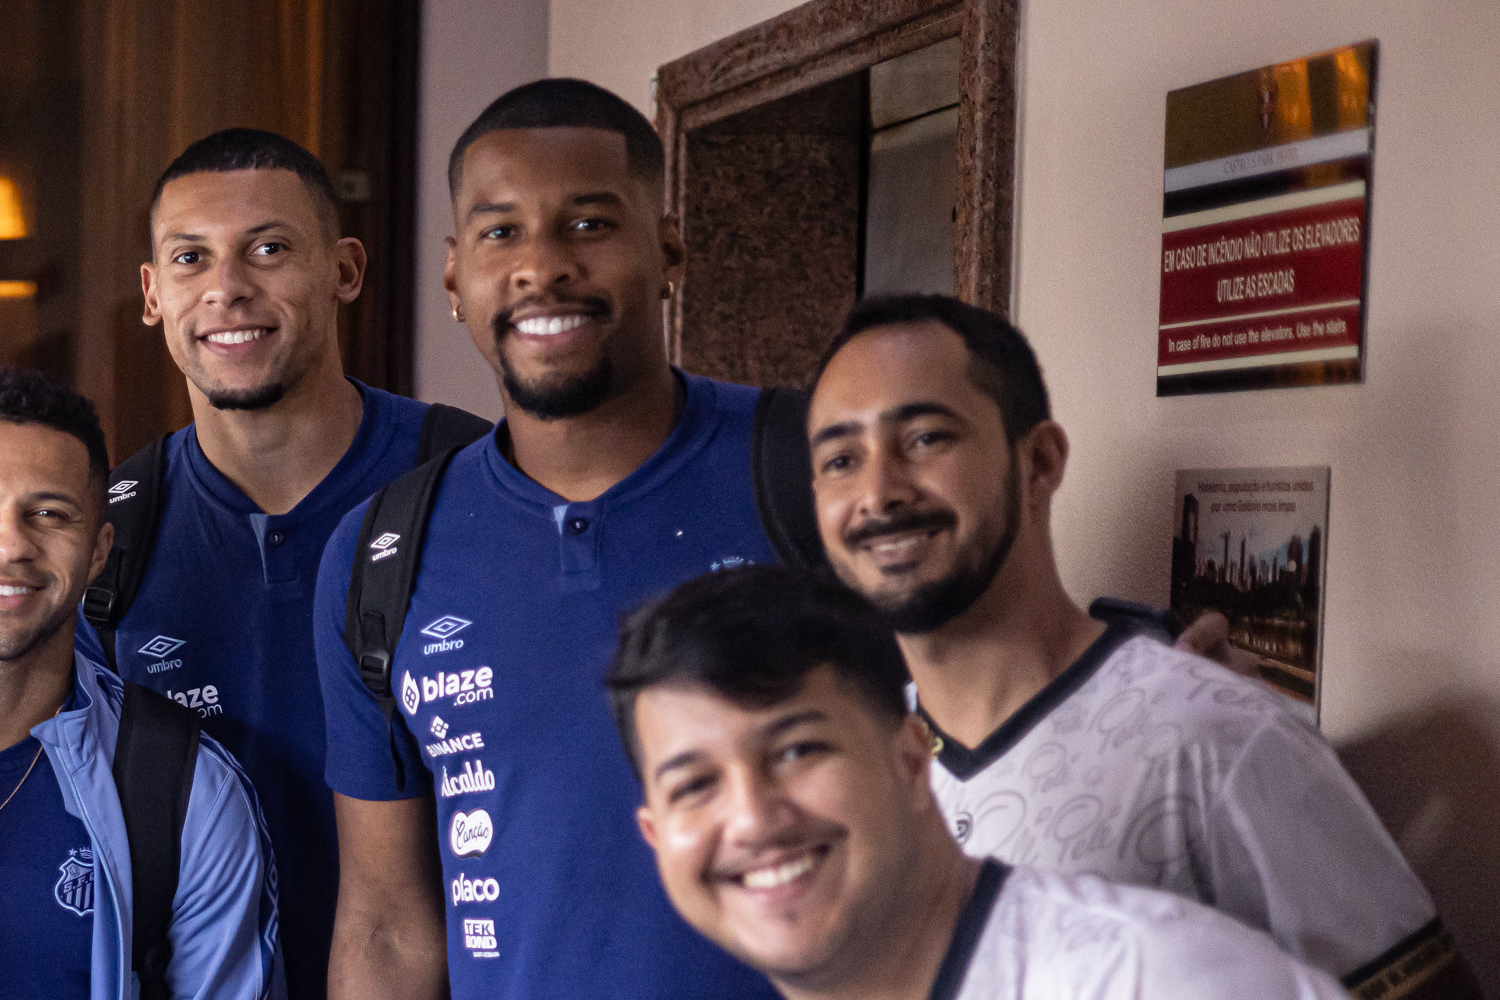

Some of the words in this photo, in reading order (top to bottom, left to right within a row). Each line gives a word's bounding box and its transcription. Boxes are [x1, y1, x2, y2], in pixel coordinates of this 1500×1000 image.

[1164, 250, 1175, 273] EM
[1176, 246, 1195, 270] CASO
[1197, 244, 1207, 267] DE
[1208, 235, 1242, 265] INCÊNDIO
[1244, 231, 1261, 259] NÃO
[1262, 229, 1291, 256] UTILIZE
[1292, 226, 1305, 250] OS
[1306, 217, 1361, 249] ELEVADORES
[1217, 276, 1245, 302] UTILIZE
[1245, 274, 1256, 298] AS
[1257, 268, 1295, 297] ESCADAS
[1168, 338, 1175, 353] In
[1176, 338, 1191, 351] case
[1192, 335, 1200, 350] of
[1200, 334, 1211, 348] fire
[1212, 333, 1221, 347] do
[1222, 333, 1233, 346] not
[1234, 333, 1247, 345] use
[1248, 329, 1259, 343] the
[1296, 322, 1311, 338] Use
[1312, 321, 1325, 336] the
[1326, 318, 1347, 334] stairs
[110, 491, 137, 503] umbro
[372, 547, 397, 561] umbro
[423, 639, 464, 655] umbro
[146, 658, 183, 674] umbro
[423, 666, 493, 702] blaze
[453, 687, 494, 706] .com
[426, 732, 485, 757] BINANCE
[456, 819, 489, 850] Canção
[452, 872, 500, 906] placo
[465, 922, 494, 935] TEK
